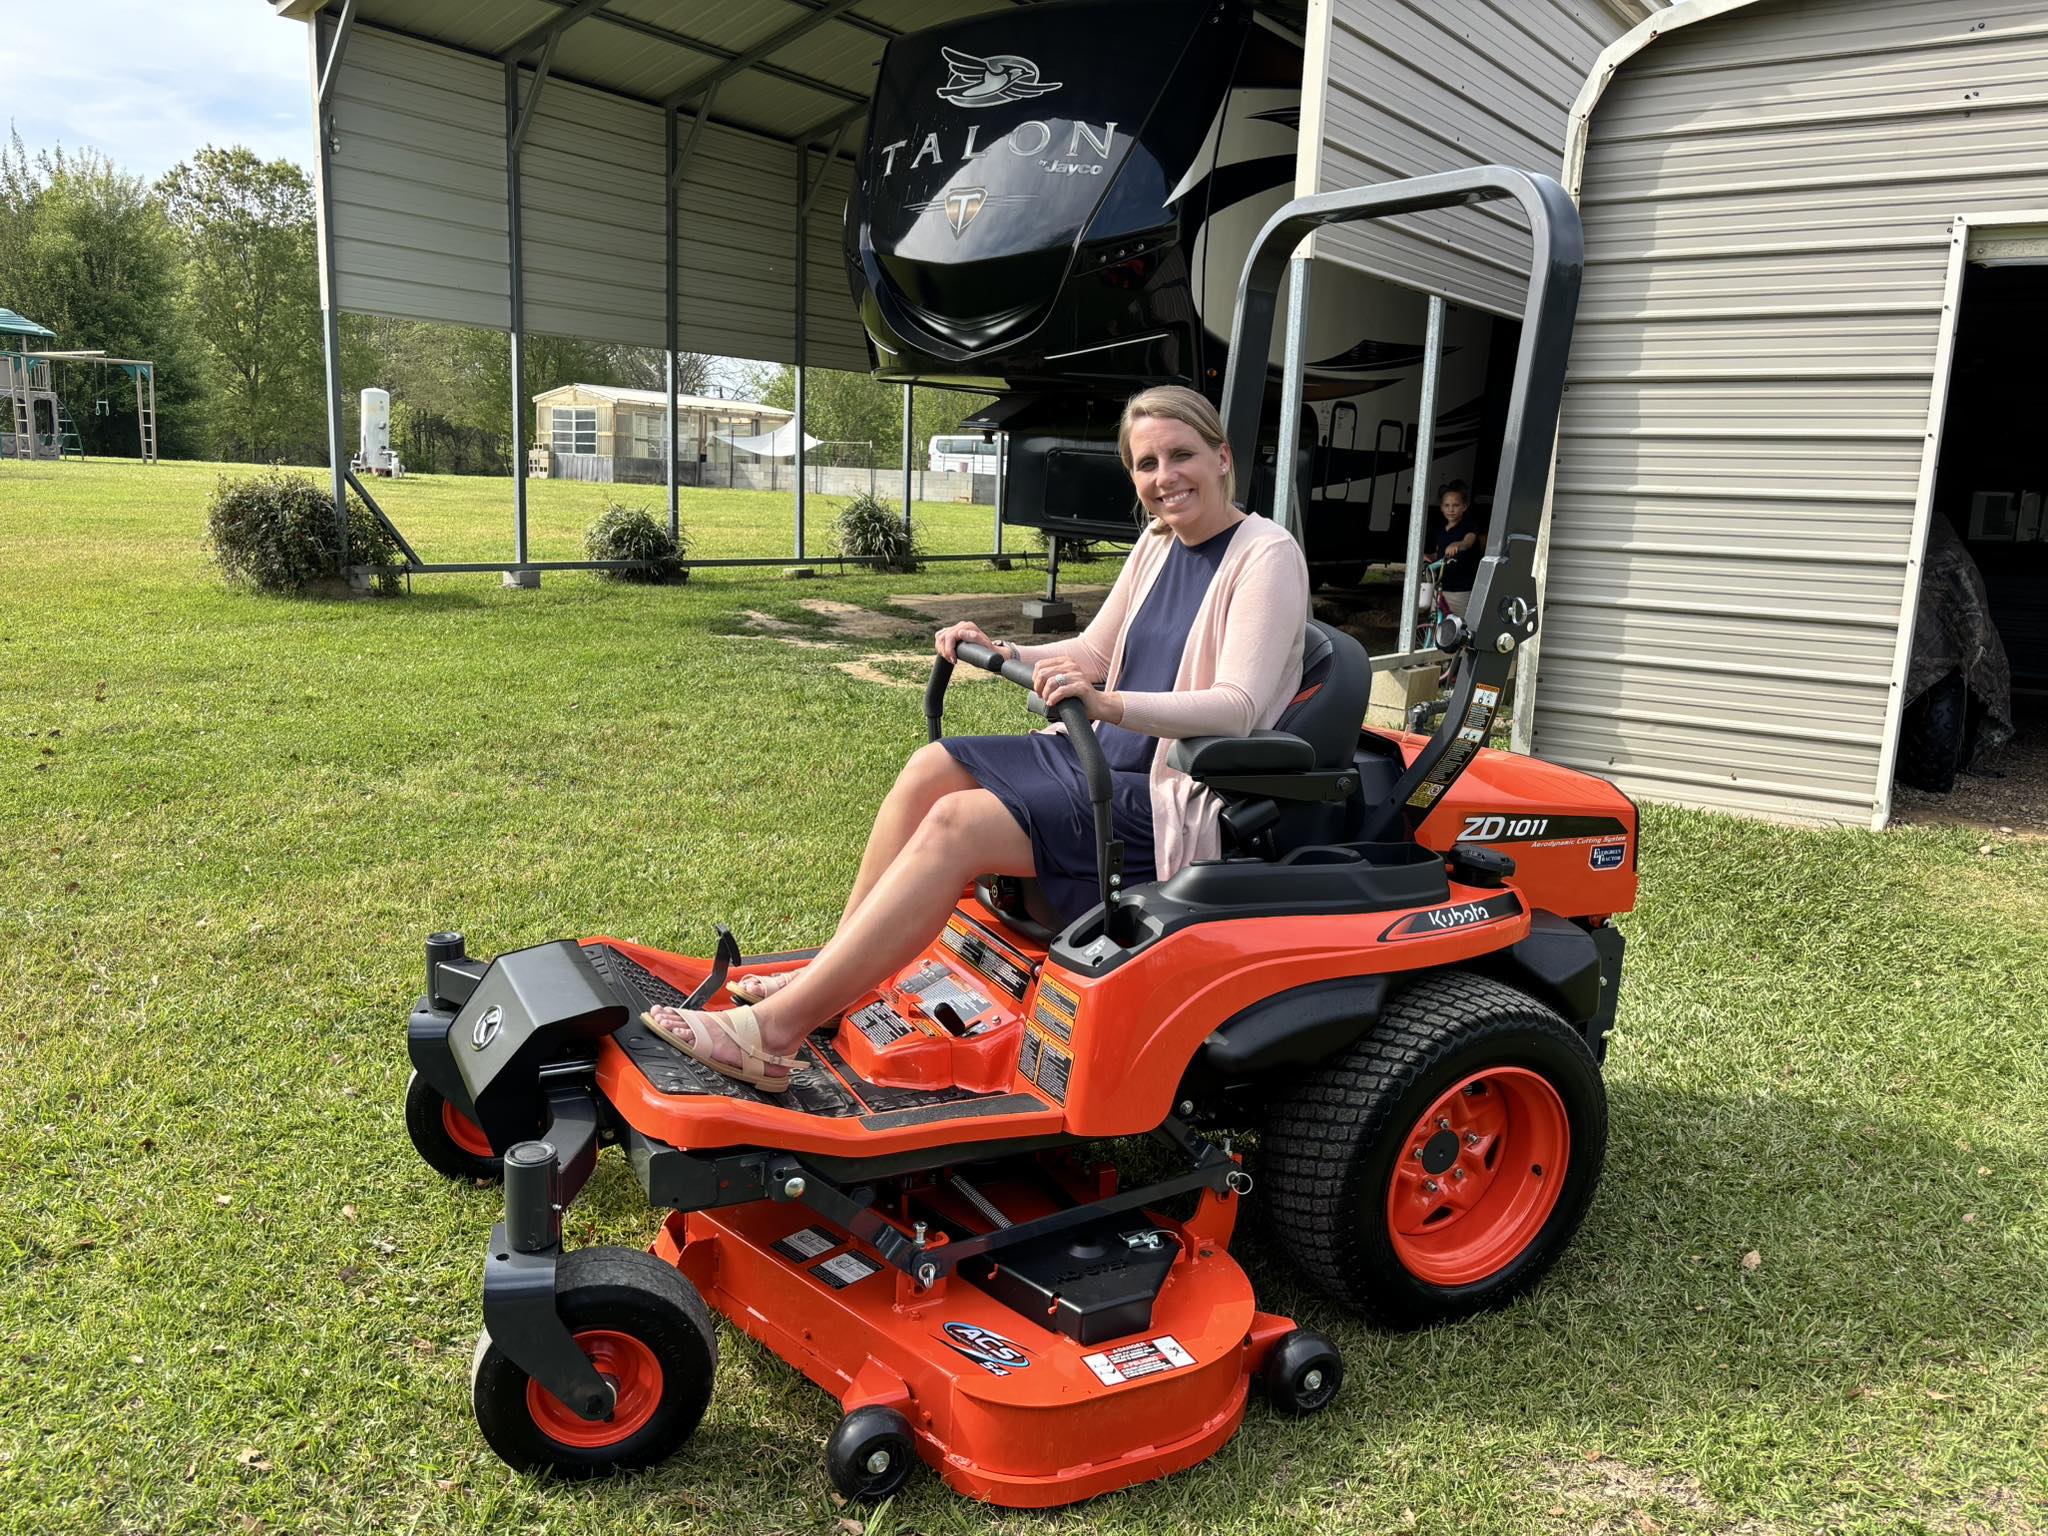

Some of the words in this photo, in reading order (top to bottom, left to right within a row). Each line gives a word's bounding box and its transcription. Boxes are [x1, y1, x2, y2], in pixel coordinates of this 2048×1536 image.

[882, 120, 1119, 177] TALON
[1045, 159, 1104, 176] Jayco
[1456, 816, 1506, 841] ZD
[1506, 819, 1549, 836] 1011
[1531, 840, 1575, 848] Aerodynamic
[1576, 837, 1602, 845] Cutting
[1428, 903, 1490, 928] Kubota
[953, 1329, 1023, 1361] ACS
[979, 1361, 1010, 1376] 54
